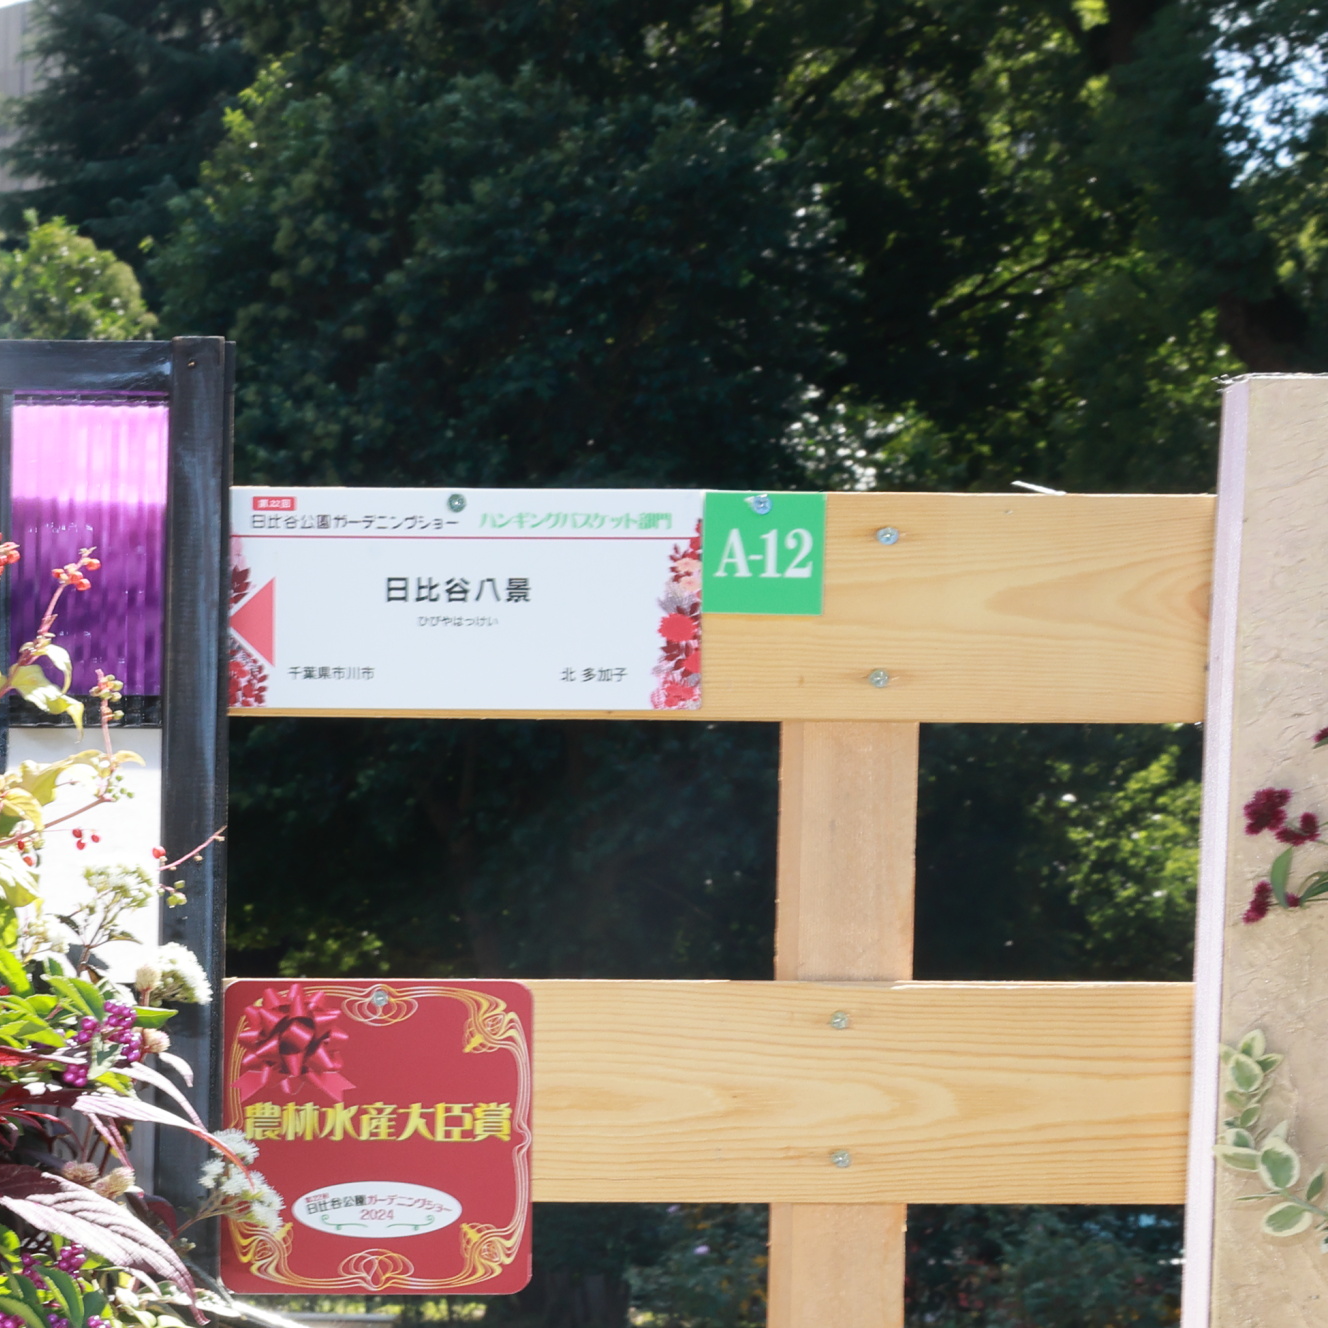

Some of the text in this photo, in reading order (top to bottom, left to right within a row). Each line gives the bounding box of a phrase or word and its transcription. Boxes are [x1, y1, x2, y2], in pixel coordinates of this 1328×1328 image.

[252, 514, 459, 530] 日比谷公園ガーデニングショー
[479, 512, 673, 529] ハンギングバスケット部門
[713, 527, 814, 579] A-12
[386, 576, 531, 602] 日比谷八景
[417, 615, 499, 627] ひびやはっけい
[288, 666, 375, 681] 千葉県市川市
[560, 667, 628, 682] 北 多加子
[244, 1101, 513, 1142] 農林水産大臣賞
[306, 1194, 453, 1215] 日比谷公園ガーデニングショー
[359, 1209, 395, 1221] 2024
